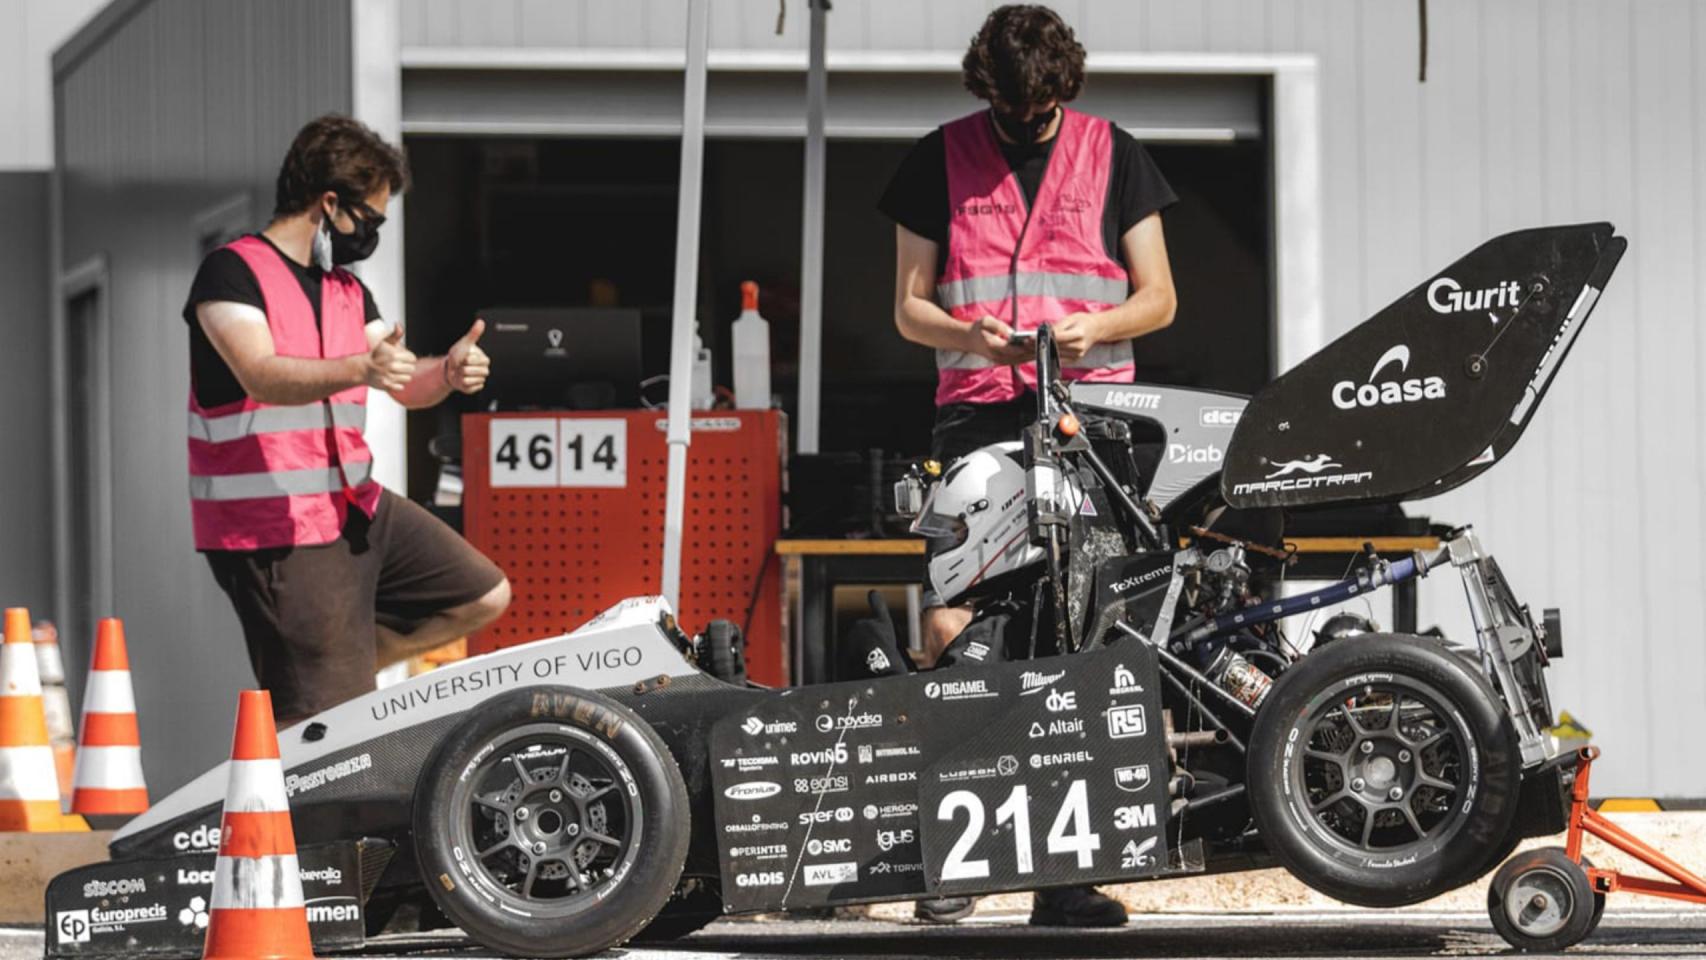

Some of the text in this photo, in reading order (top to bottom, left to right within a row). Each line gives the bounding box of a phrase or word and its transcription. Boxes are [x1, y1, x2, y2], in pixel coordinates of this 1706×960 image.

[1427, 277, 1521, 314] Gurit
[1104, 391, 1161, 409] LOCTITE
[1332, 375, 1446, 410] Coasa
[1168, 443, 1222, 463] Diab
[1233, 472, 1373, 495] MARCOTRAN
[1109, 564, 1172, 594] TeXtreme
[371, 646, 642, 721] UNIVERSITY OF VIGO
[942, 680, 988, 695] DIGAMEL
[765, 719, 797, 734] unimec
[1048, 718, 1084, 736] Altair
[1112, 708, 1143, 735] RS
[865, 772, 917, 784] AIRBOX
[1117, 770, 1147, 783] WD-40
[730, 785, 776, 796] Fronius
[1114, 804, 1157, 830] 3M
[877, 829, 914, 851] igus
[937, 779, 1101, 881] 214
[824, 839, 852, 853] SMC
[736, 872, 784, 887] GADIS
[812, 870, 835, 880] AVL
[91, 903, 167, 923] Europrecis
